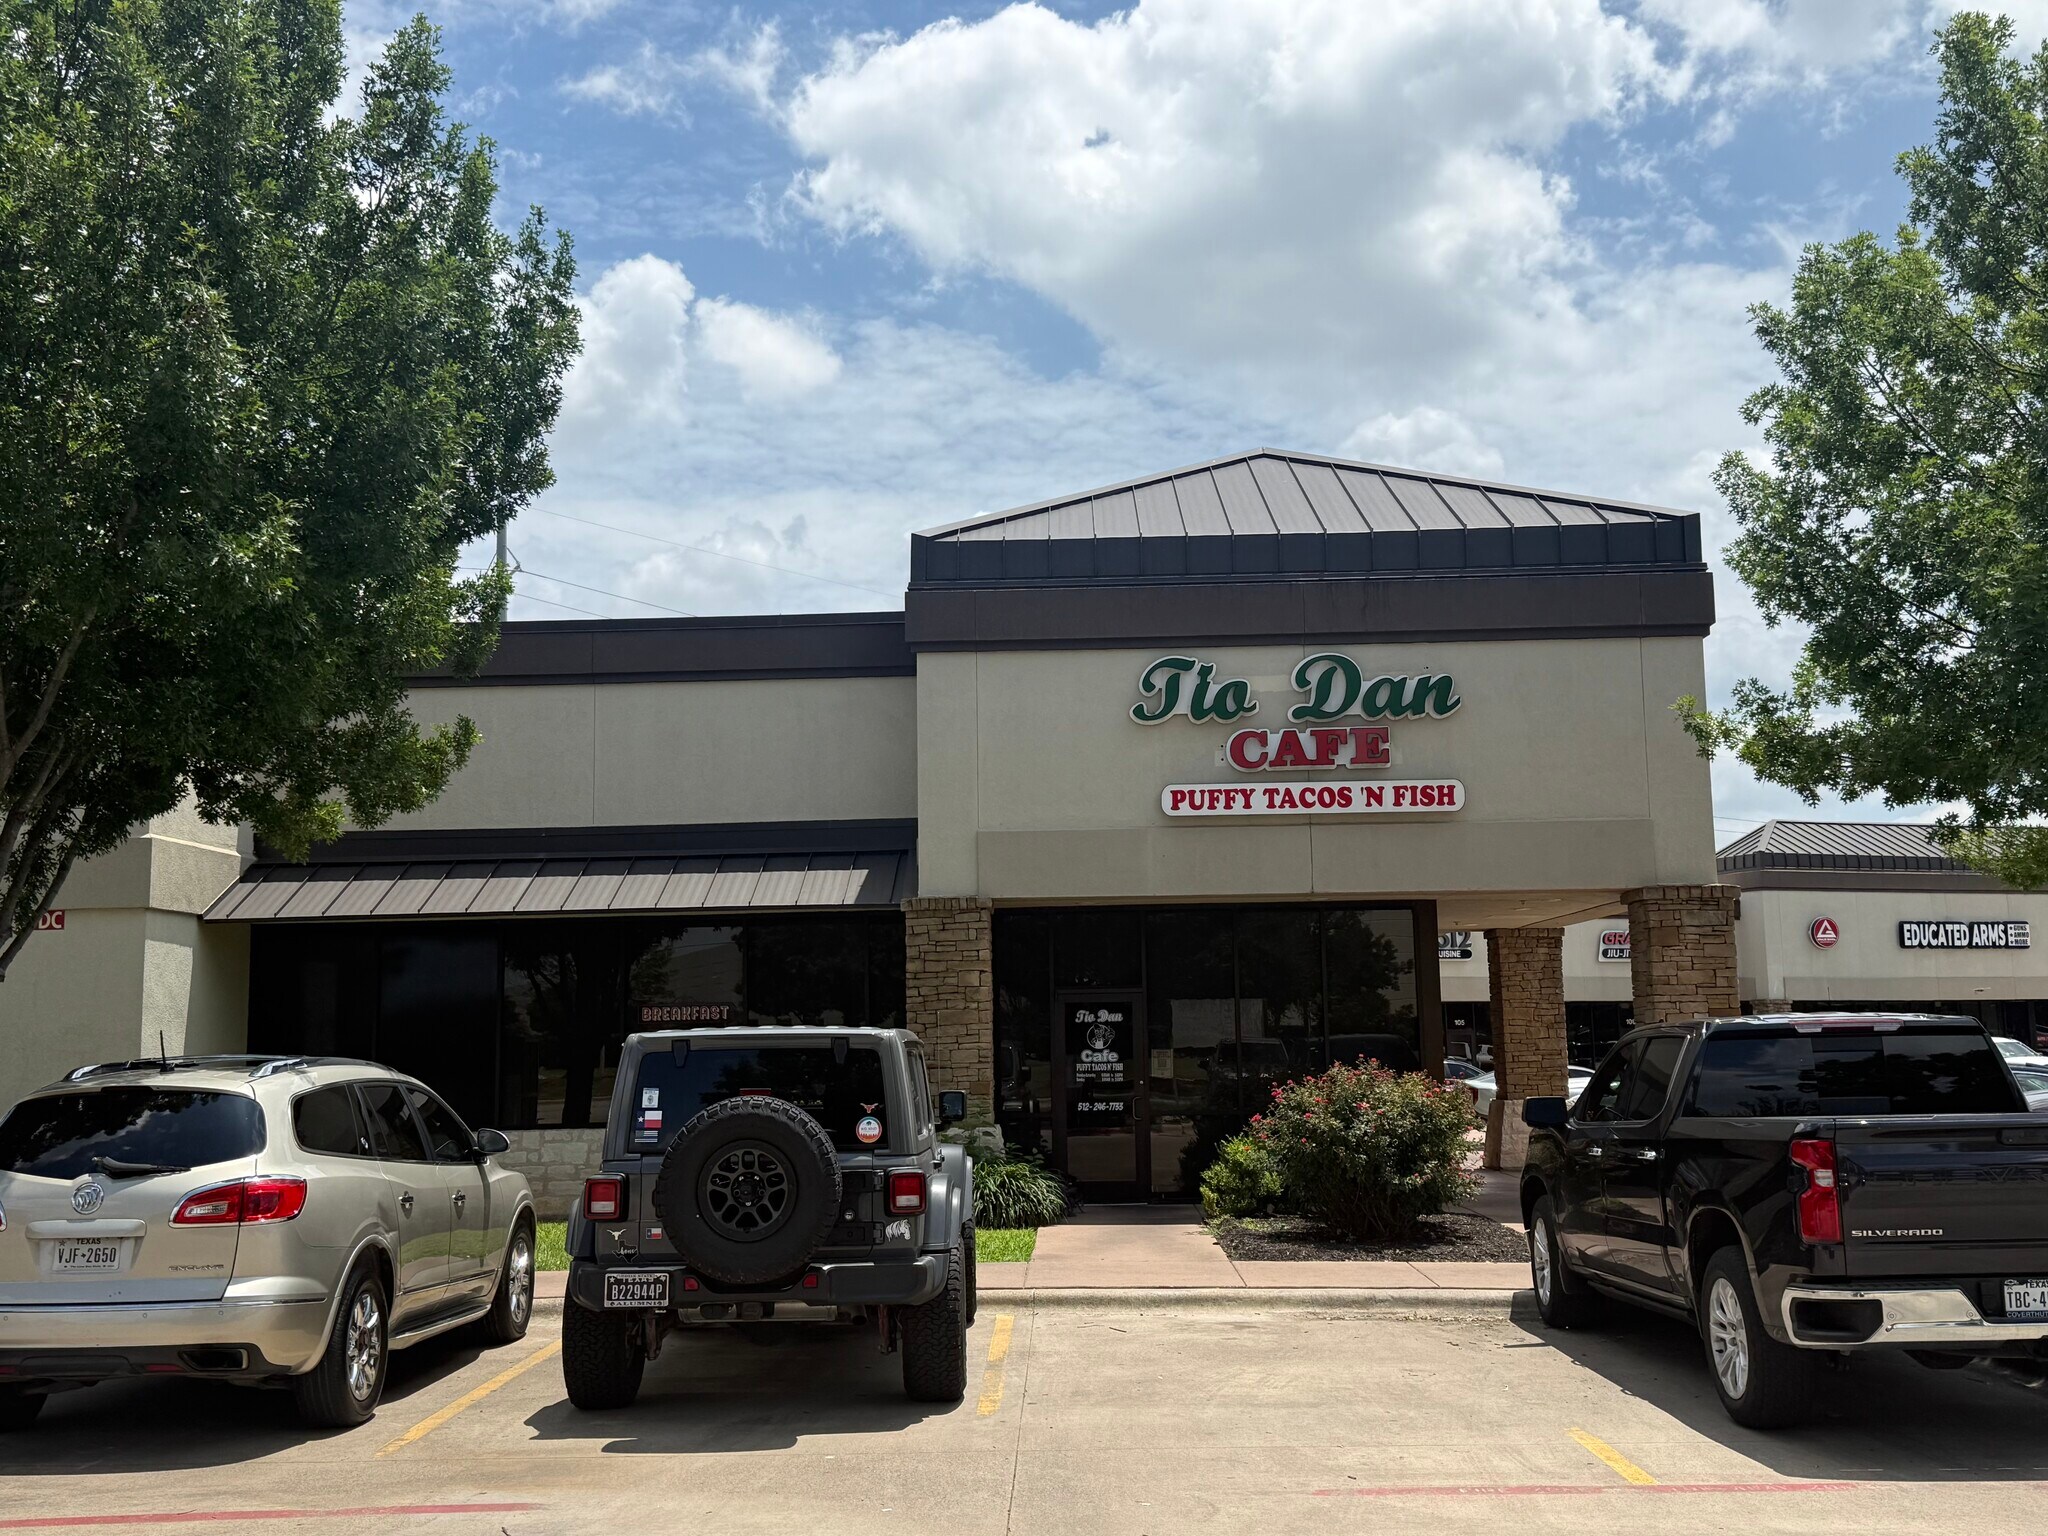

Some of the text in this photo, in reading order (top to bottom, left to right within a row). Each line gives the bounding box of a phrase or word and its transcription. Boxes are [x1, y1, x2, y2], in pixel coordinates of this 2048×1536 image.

[1130, 652, 1462, 725] Tio Dan
[1229, 726, 1390, 769] CAFE
[1170, 784, 1456, 811] PUFFY TACOS 'N FISH
[38, 911, 63, 929] DC
[1903, 923, 2006, 946] EDUCATED ARMS
[641, 1005, 729, 1021] BREAKFAST
[1075, 1009, 1124, 1023] Tio Dan
[1080, 1049, 1119, 1062] Cafe
[1092, 1063, 1107, 1071] TACOS
[1851, 1228, 1943, 1237] SILVERADO
[611, 1284, 663, 1300] B22944P
